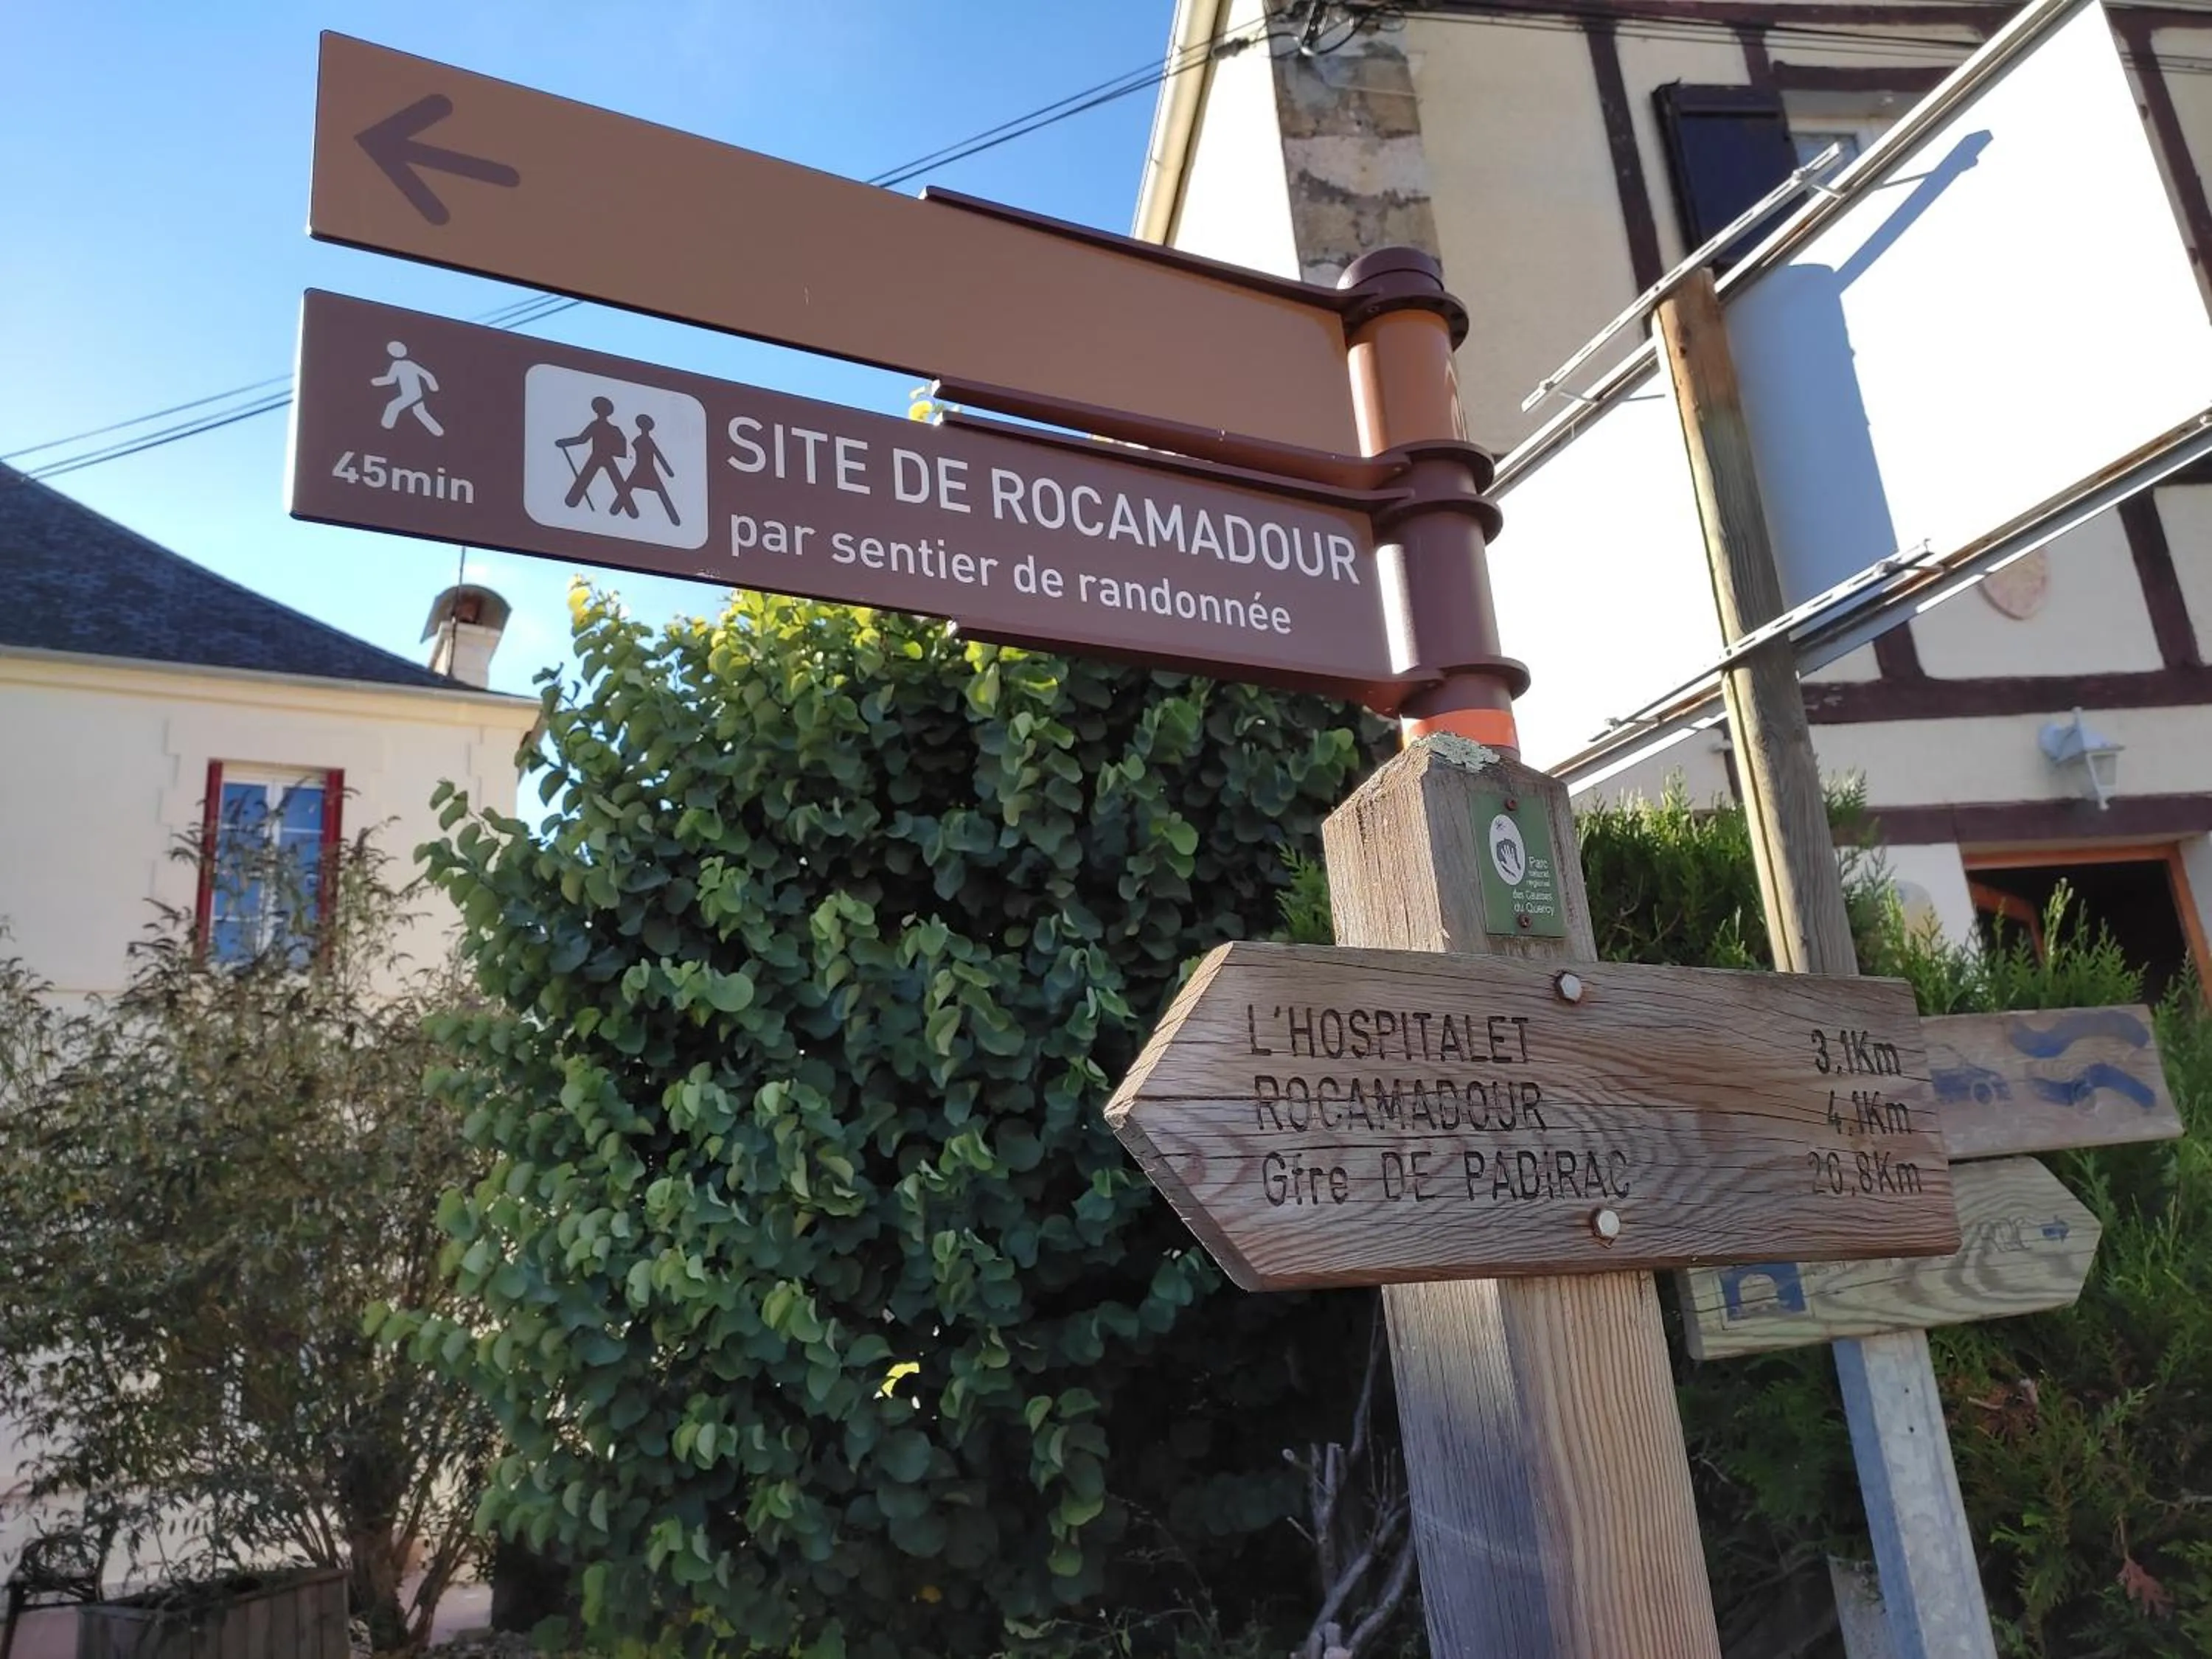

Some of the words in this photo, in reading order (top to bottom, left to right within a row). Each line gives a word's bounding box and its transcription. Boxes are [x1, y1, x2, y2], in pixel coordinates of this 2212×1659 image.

[332, 451, 474, 504] 45min
[727, 416, 871, 495] SITE
[893, 448, 971, 513] DE
[991, 467, 1360, 585] ROCAMADOUR
[731, 514, 817, 557] par
[831, 532, 998, 586] sentier
[1013, 555, 1064, 598] de
[1079, 573, 1292, 634] randonnée
[1247, 1004, 1529, 1064] L'HOSPITALET
[1253, 1075, 1548, 1133] ROCAMADOUR
[1381, 1151, 1436, 1203] DE
